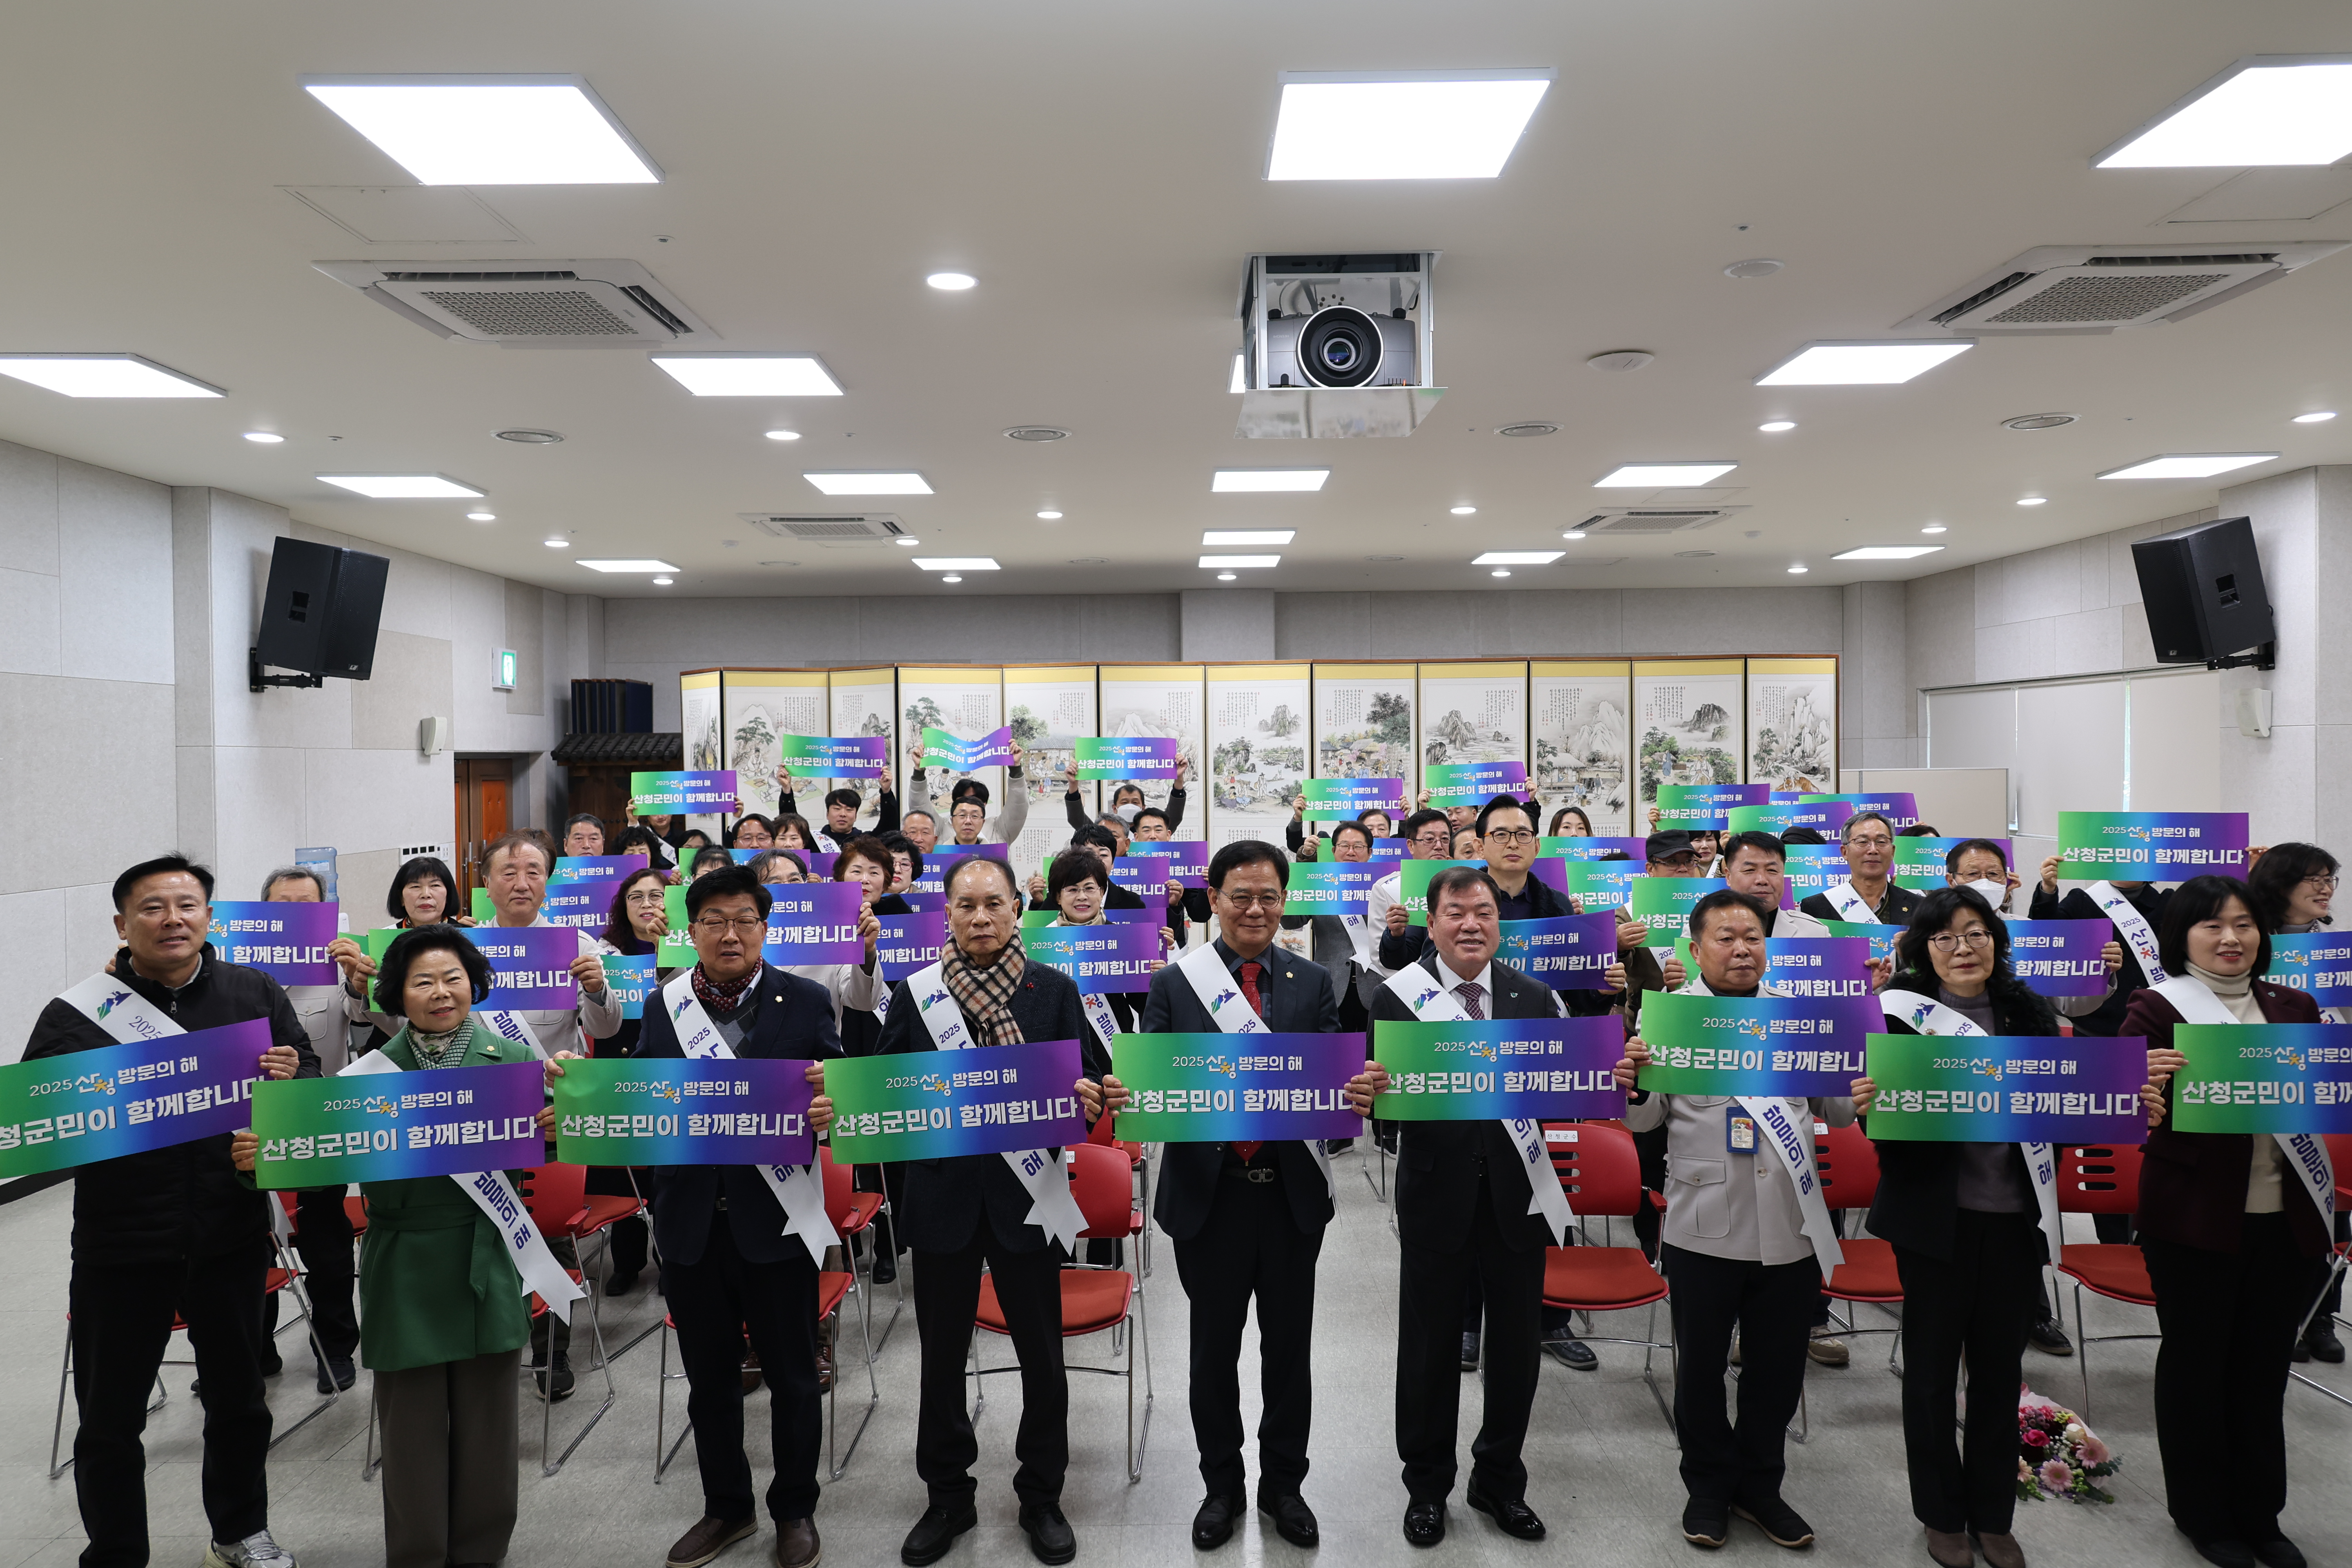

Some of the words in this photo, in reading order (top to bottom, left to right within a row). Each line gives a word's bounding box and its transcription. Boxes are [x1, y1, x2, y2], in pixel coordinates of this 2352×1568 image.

[784, 757, 831, 766] 산청군민이
[835, 758, 883, 768] 함께합니다
[923, 748, 965, 764] 산청군민이
[967, 746, 1009, 764] 함께합니다
[1078, 760, 1124, 769] 산청군민이
[1127, 760, 1174, 769] 함께합니다
[634, 794, 683, 804] 산청군민이
[686, 792, 735, 803] 함께합니다
[1430, 787, 1475, 797] 산청군민이
[1478, 782, 1526, 794] 함께합니다
[1306, 800, 1351, 810] 산청군민이
[1660, 809, 1711, 819] 산청군민이
[2152, 828, 2186, 838] 방문의
[2189, 828, 2200, 838] 해
[2063, 848, 2149, 863] 산청군민이
[2155, 849, 2243, 864] 함께합니다
[579, 867, 604, 876] 방문의
[230, 920, 267, 932] 방문의
[270, 920, 283, 932] 해
[2122, 917, 2141, 927] 2025
[766, 926, 857, 944] 함께합니다
[1532, 933, 1566, 946] 방문의
[1568, 933, 1579, 943] 해
[1075, 940, 1104, 950] 방문의
[1107, 940, 1117, 949] 해
[233, 946, 330, 964] 함께합니다
[1533, 952, 1616, 971] 함께합니다
[2016, 960, 2105, 976] 함께합니다
[488, 970, 573, 989] 께합니다
[1776, 980, 1867, 997] 함께합니다
[939, 1023, 960, 1044] 2025
[1702, 1018, 1735, 1028] 2025
[1770, 1020, 1815, 1034] 방문의
[1819, 1020, 1833, 1034] 해
[687, 1027, 711, 1050] 2025
[1434, 1042, 1465, 1051] 2025
[1500, 1041, 1544, 1055] 방문의
[1548, 1040, 1563, 1054] 해
[1650, 1045, 1763, 1071] 산청군민이
[1773, 1050, 1864, 1073] 함께합니
[2239, 1048, 2272, 1058] 2025
[1172, 1056, 1204, 1067] 2025
[1239, 1056, 1283, 1071] 방문의
[1288, 1056, 1302, 1071] 해
[1933, 1058, 1967, 1069] 2025
[2005, 1059, 2056, 1074] 방문의
[2060, 1060, 2076, 1074] 해
[29, 1079, 73, 1096] 2025
[118, 1060, 176, 1085] 방문의
[181, 1056, 198, 1072] 해
[886, 1076, 918, 1089] 2025
[953, 1070, 998, 1088] 방문의
[1002, 1068, 1017, 1084] 해
[1386, 1072, 1495, 1094] 산청군민이
[1503, 1071, 1617, 1092] 함께합니다
[615, 1082, 648, 1093] 2025
[683, 1081, 730, 1096] 방문의
[734, 1081, 749, 1096] 해
[2182, 1082, 2304, 1104] 산청군민이
[324, 1099, 360, 1111] 2025
[401, 1091, 452, 1109] 방문의
[457, 1090, 473, 1104] 해
[1121, 1089, 1235, 1113] 산청군민이
[1875, 1090, 2000, 1113] 산청군민이
[2010, 1092, 2140, 1116] 함께합니다
[561, 1114, 679, 1138] 산청군민이
[688, 1113, 805, 1137] 함께합니다
[835, 1106, 951, 1138] 산청군민이
[959, 1096, 1078, 1128] 함께합니다
[0, 1106, 116, 1149] 청군민이
[261, 1129, 397, 1161] 산청군민이
[407, 1116, 537, 1149] 함께합니다
[1526, 1139, 1541, 1164] 해
[1762, 1105, 1806, 1169] 방문의
[1800, 1171, 1813, 1195] 해
[1021, 1151, 1044, 1176] 해
[2038, 1160, 2052, 1185] 해
[513, 1223, 531, 1250] 해
